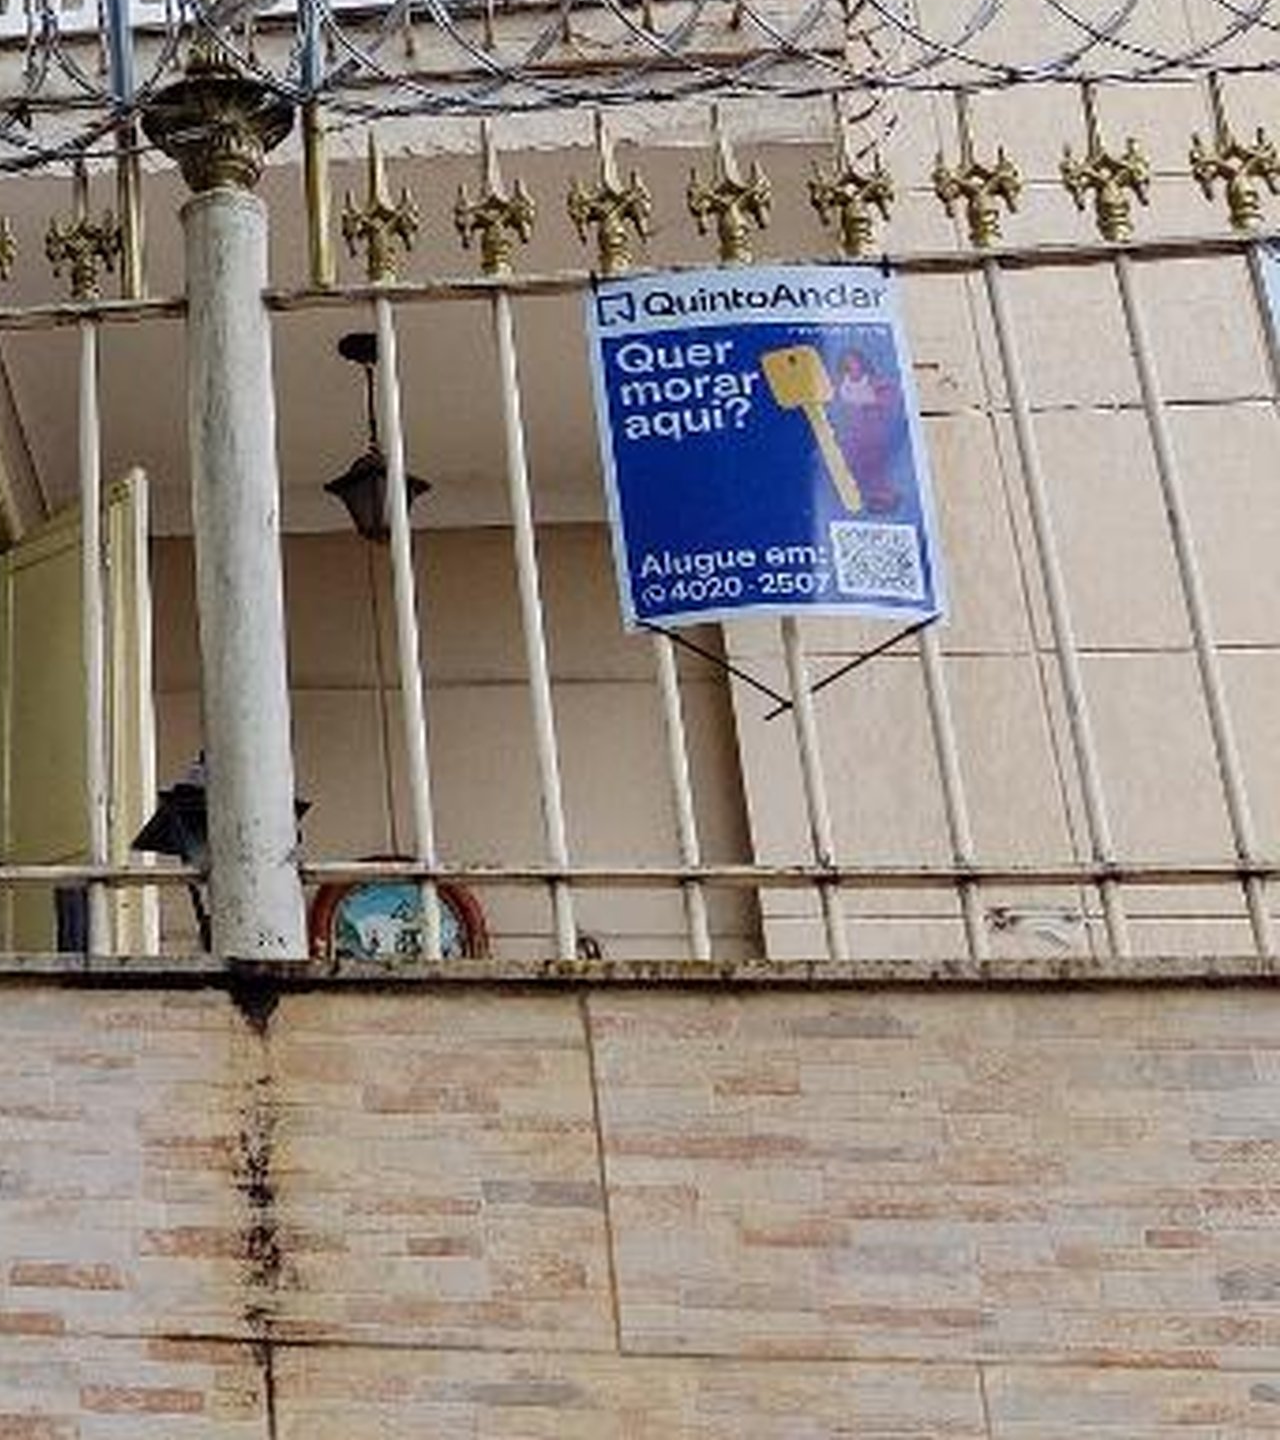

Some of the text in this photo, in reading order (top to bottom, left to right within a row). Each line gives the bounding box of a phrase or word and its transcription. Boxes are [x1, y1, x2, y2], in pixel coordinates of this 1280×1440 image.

[643, 283, 886, 317] QuintoAndar
[616, 339, 733, 374] Quer
[621, 371, 760, 407] morar
[624, 400, 752, 441] aqui?
[640, 545, 828, 579] Alugue em:
